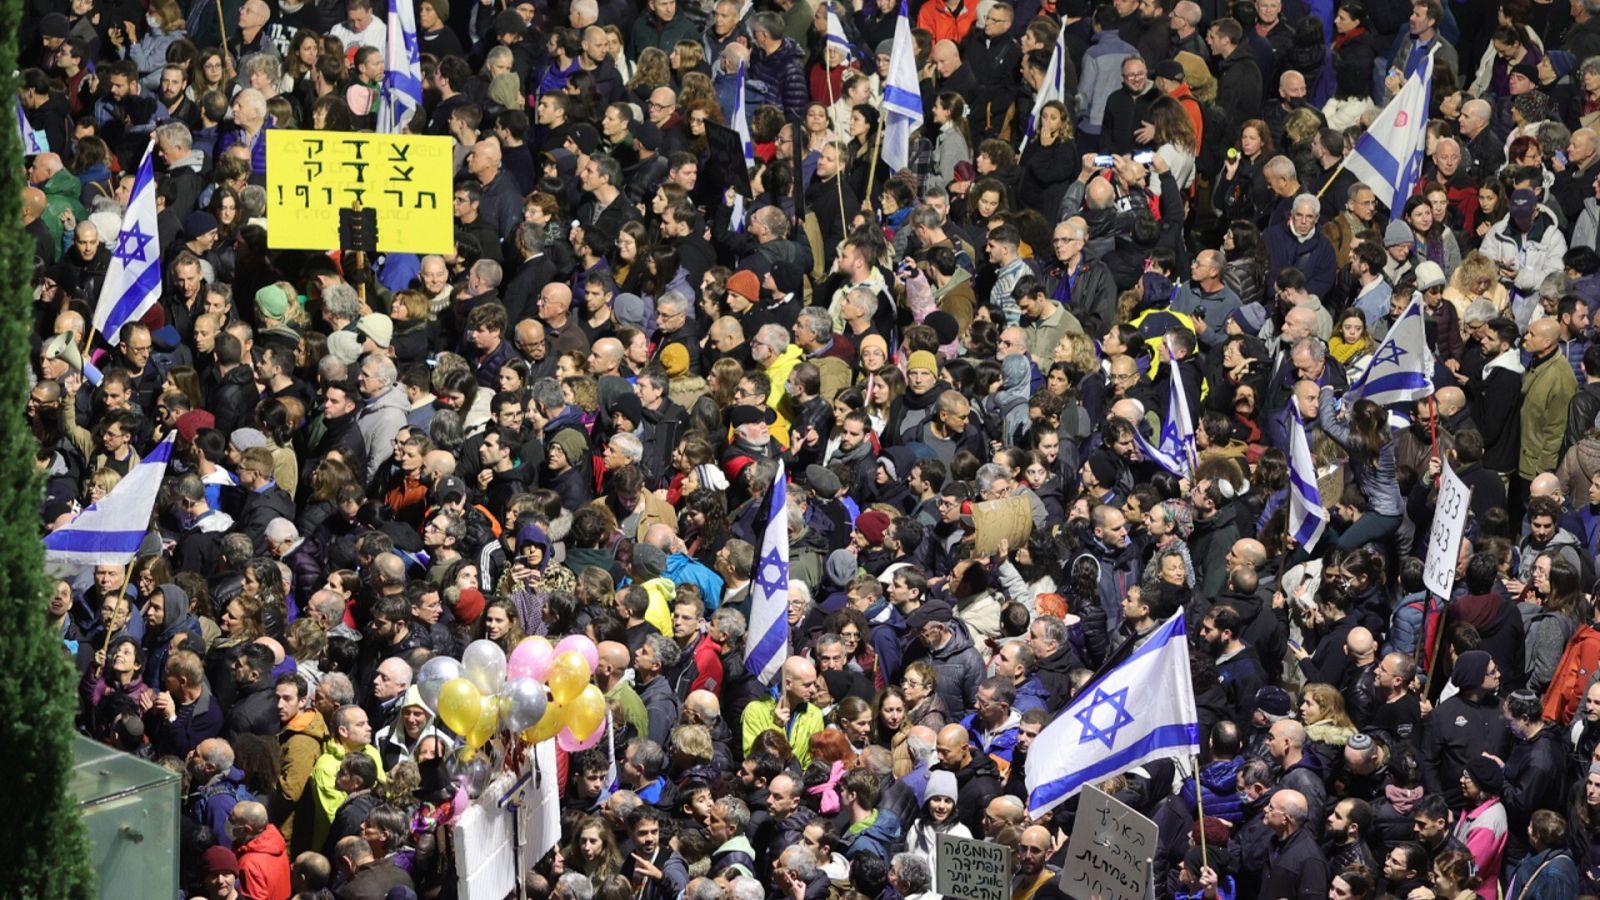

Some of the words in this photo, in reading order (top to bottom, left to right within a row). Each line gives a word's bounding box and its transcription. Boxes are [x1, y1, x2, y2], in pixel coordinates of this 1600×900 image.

[1095, 808, 1145, 846] בארץ
[944, 840, 1003, 862] הממשלה
[951, 857, 1005, 874] מפחידה
[1075, 849, 1139, 892] השחיתות
[947, 869, 972, 884] יותר
[976, 875, 1004, 888] אותי
[1073, 872, 1129, 900] ורחת
[952, 884, 1002, 900] מהגשם
